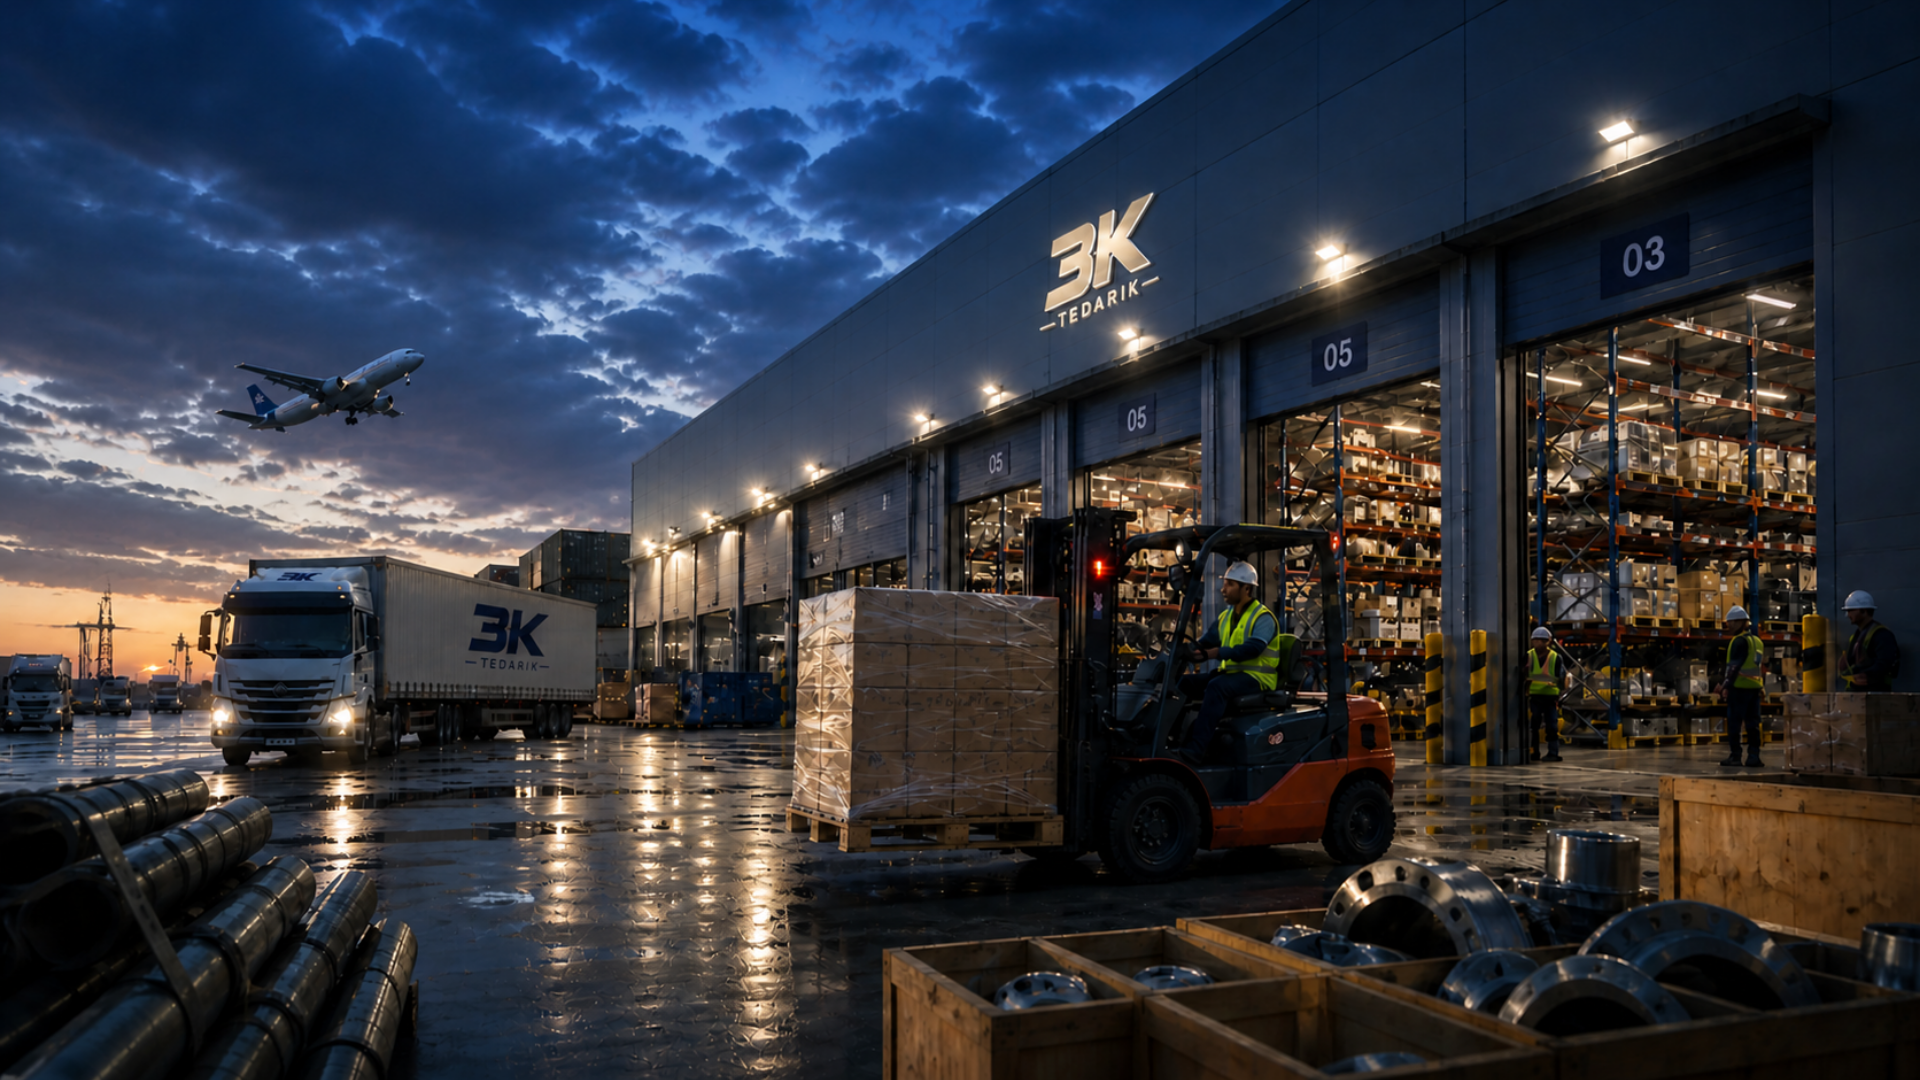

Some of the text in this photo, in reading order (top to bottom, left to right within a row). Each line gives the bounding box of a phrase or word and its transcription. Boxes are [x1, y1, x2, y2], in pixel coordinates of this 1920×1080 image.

[1044, 192, 1154, 312] 3K
[1623, 235, 1665, 278] 03
[1057, 279, 1139, 328] TEDARIK
[1323, 337, 1353, 372] 05
[1127, 404, 1147, 432] 05
[988, 451, 1003, 474] 05
[468, 603, 549, 657] 3K
[480, 657, 538, 671] TEDARIK
